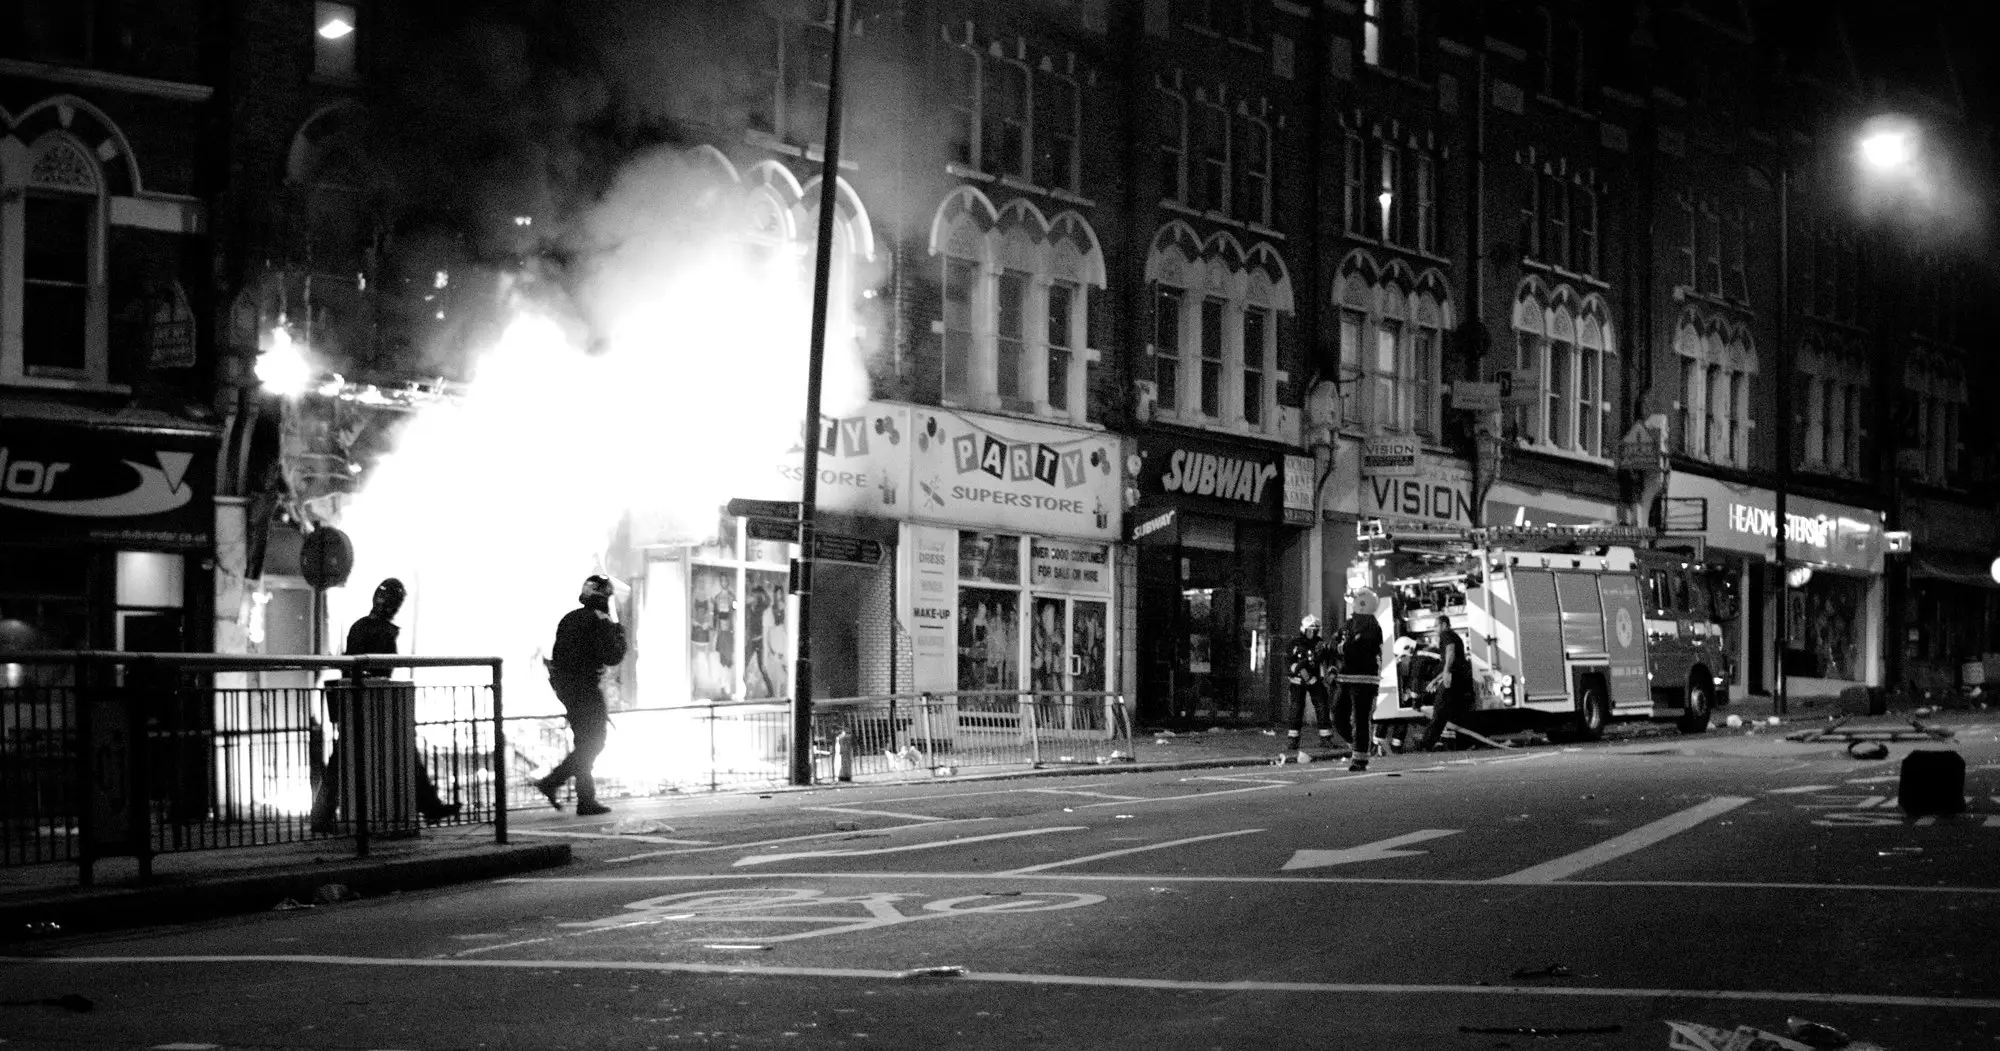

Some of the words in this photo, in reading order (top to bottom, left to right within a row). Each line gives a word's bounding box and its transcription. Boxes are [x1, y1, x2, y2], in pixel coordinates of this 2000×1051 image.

[956, 437, 1082, 484] PARTY
[1365, 444, 1415, 455] VISION
[1162, 449, 1278, 503] SUBWAY
[951, 485, 1084, 514] SUPERSTORE
[1371, 476, 1474, 523] VISION
[1132, 509, 1176, 540] SUBWAY
[1728, 503, 1824, 547] HEADMSTERS
[918, 551, 946, 566] DRESS
[913, 607, 951, 620] MAKE-UP
